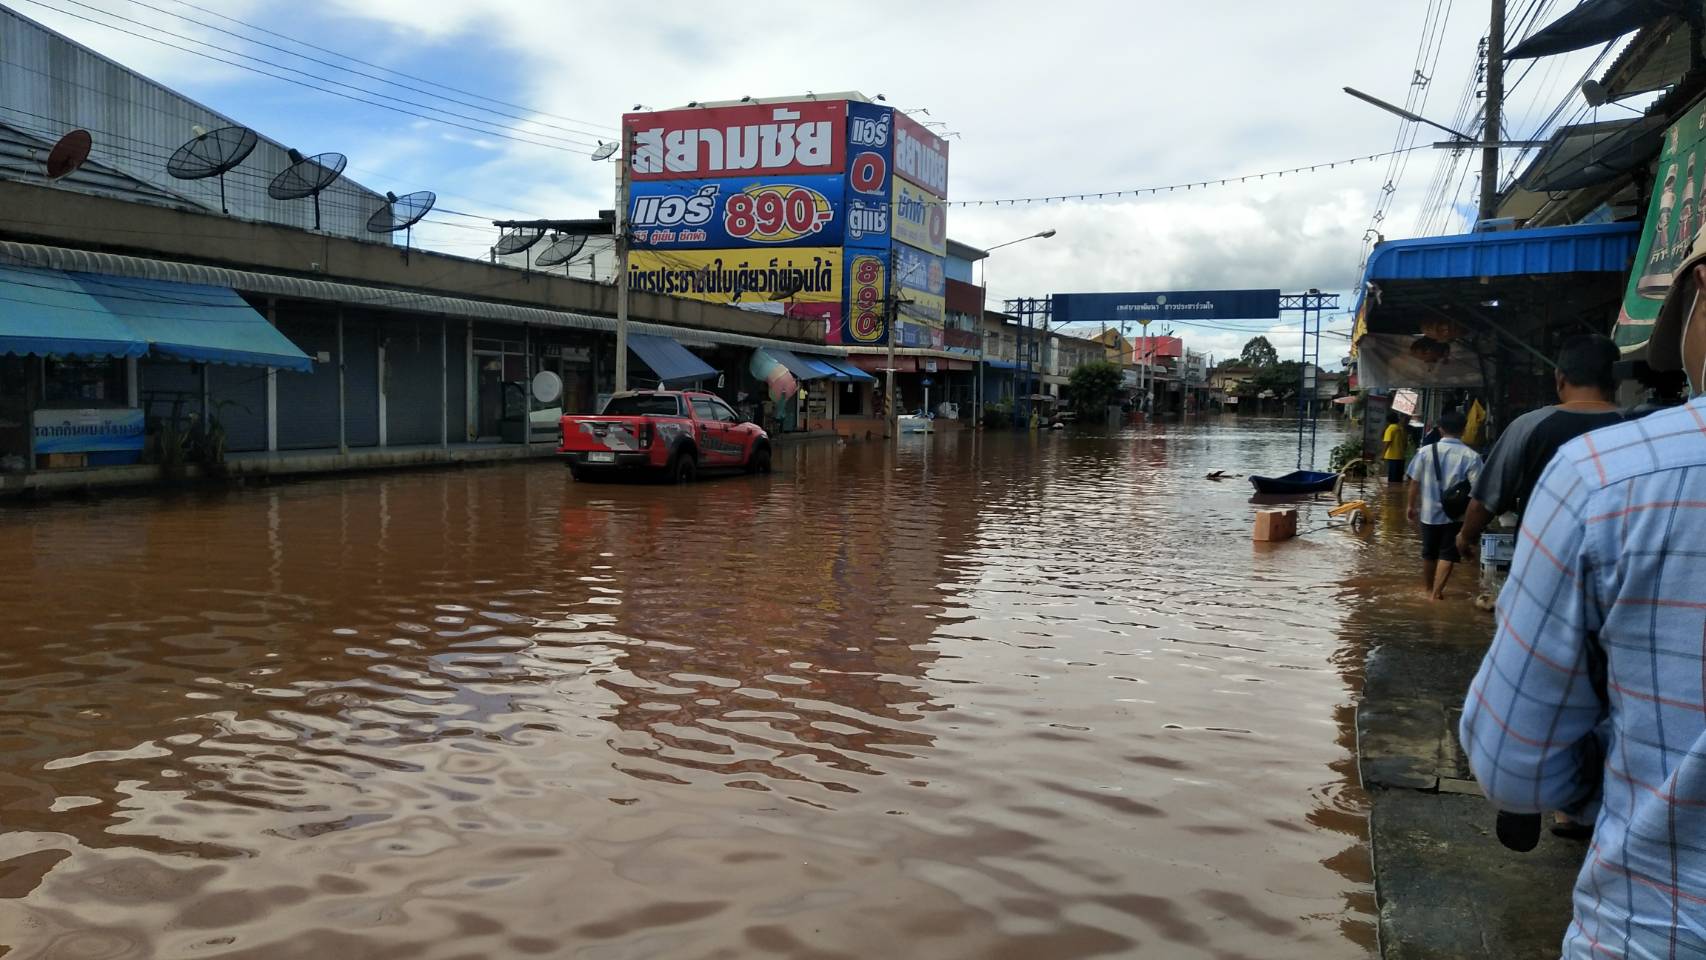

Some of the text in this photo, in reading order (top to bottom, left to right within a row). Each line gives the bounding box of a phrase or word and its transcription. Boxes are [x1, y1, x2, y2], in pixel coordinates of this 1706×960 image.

[631, 107, 832, 174] สยามชัย
[851, 113, 890, 148] แอร์
[895, 128, 946, 192] สยามชัย
[631, 183, 834, 239] แอร์ 890.-
[849, 199, 888, 240] ตู้แช่
[628, 256, 833, 294] บัตรประชาชนใบเดียวก็ผ่อนได้
